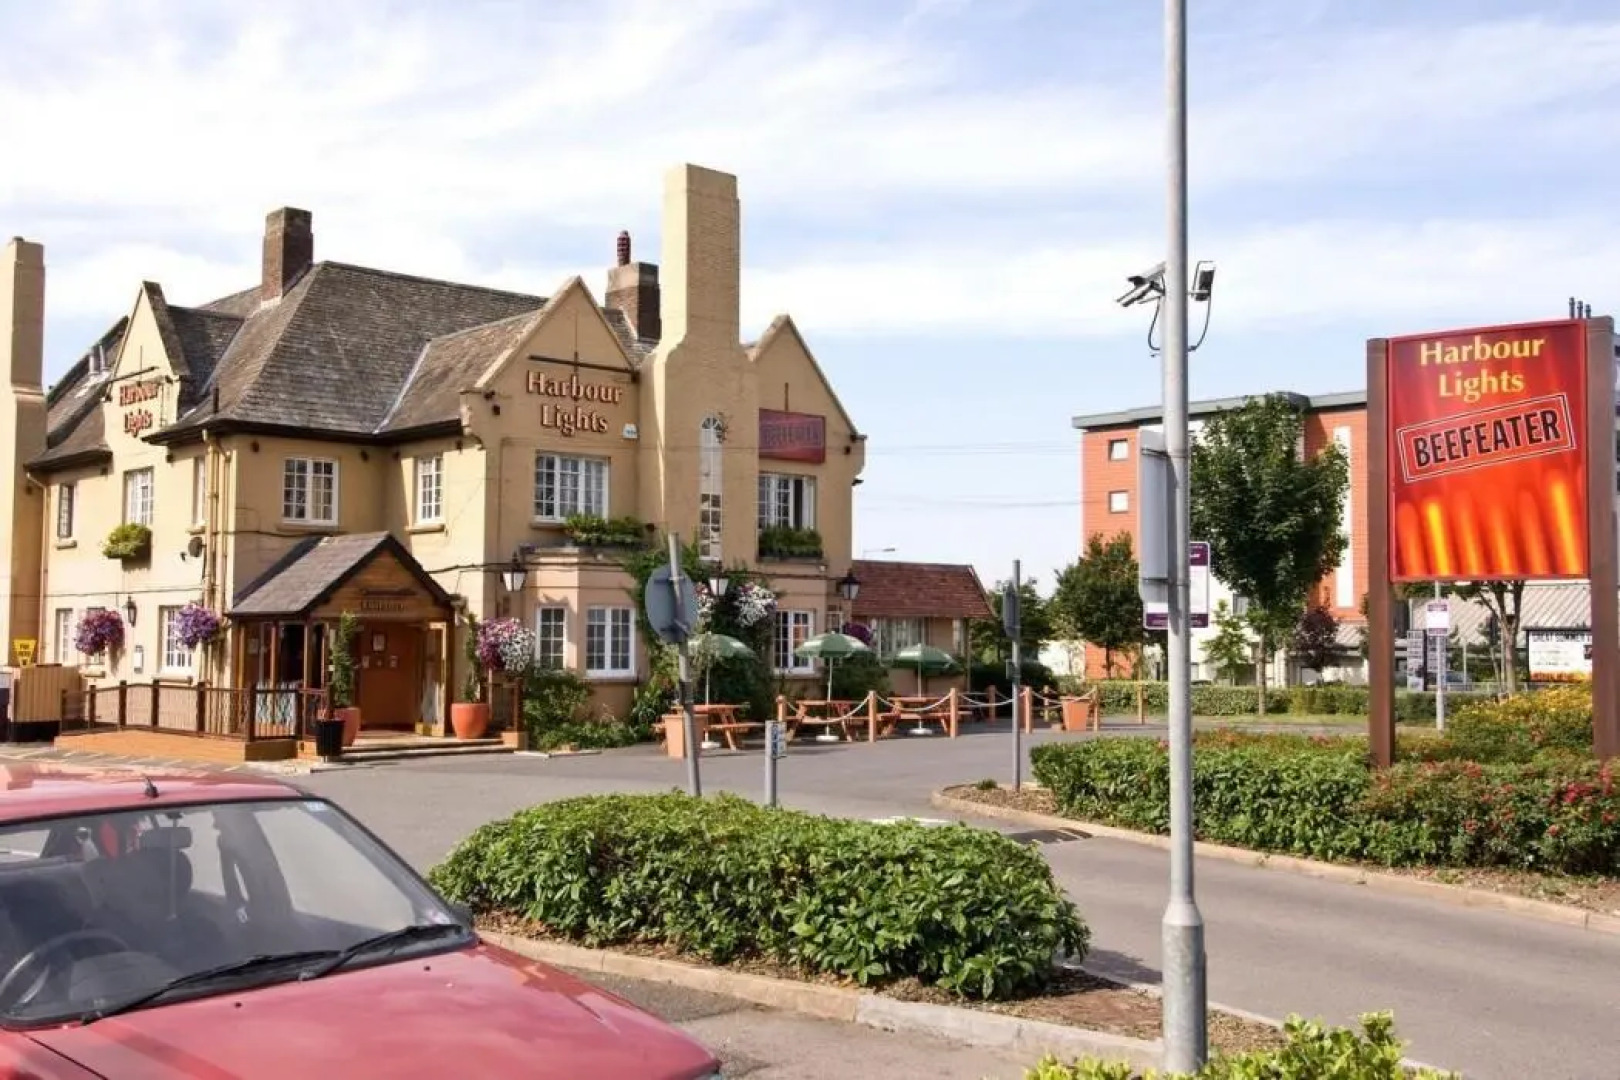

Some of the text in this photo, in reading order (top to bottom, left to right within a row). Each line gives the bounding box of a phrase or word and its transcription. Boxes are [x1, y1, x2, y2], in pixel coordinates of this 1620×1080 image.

[1420, 335, 1545, 366] Harbour
[526, 370, 623, 404] Harbour
[1439, 369, 1525, 403] Lights
[541, 403, 608, 437] Lights
[1413, 409, 1561, 467] BEEFEATER
